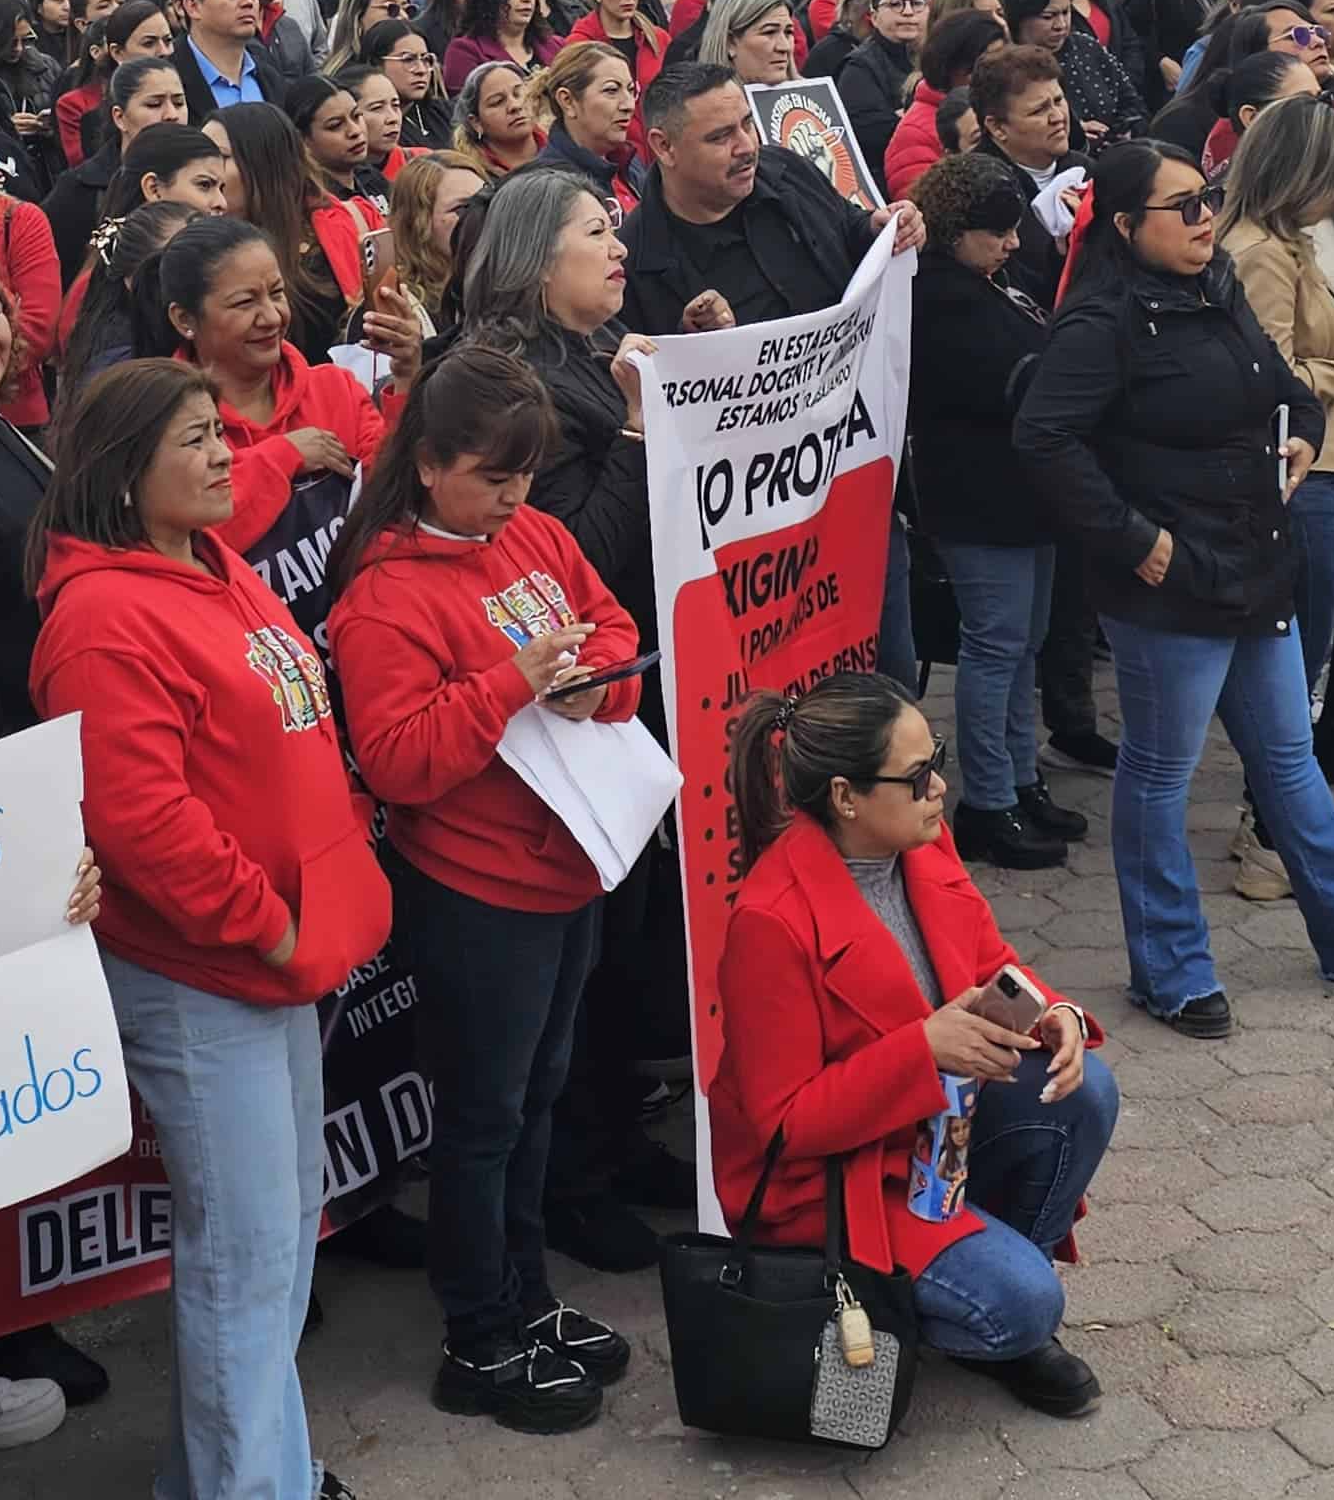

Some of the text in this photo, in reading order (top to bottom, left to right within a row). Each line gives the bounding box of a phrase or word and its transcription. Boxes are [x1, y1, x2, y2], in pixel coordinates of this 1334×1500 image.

[757, 339, 784, 366] EN
[784, 331, 818, 362] ESTA
[661, 350, 830, 409] RSONAL DOCENTE Y
[715, 392, 800, 433] ESTAMOS
[817, 572, 840, 612] DE
